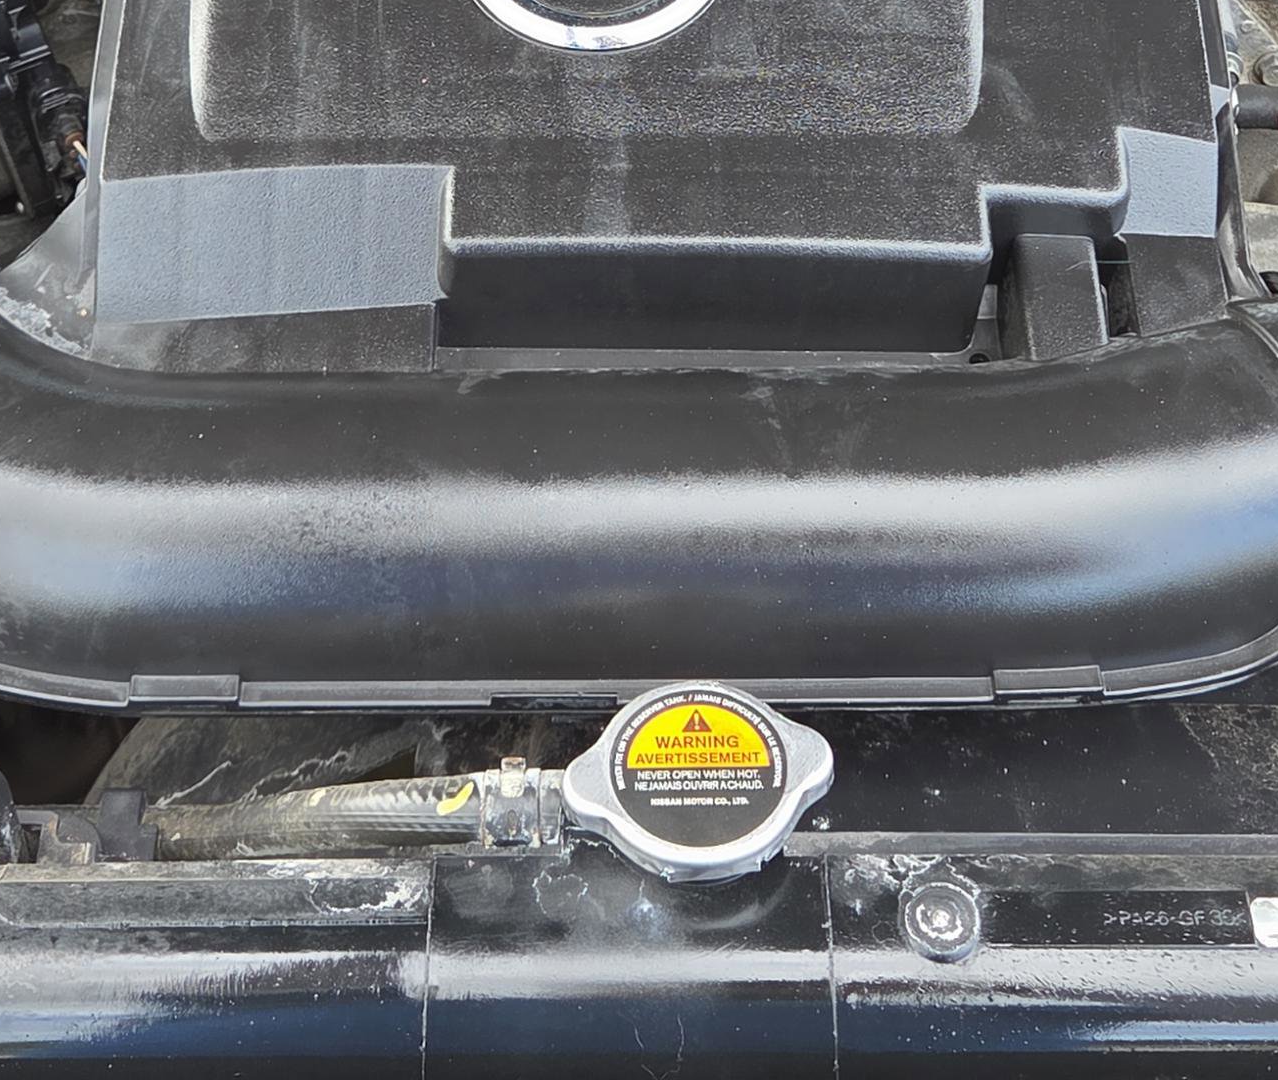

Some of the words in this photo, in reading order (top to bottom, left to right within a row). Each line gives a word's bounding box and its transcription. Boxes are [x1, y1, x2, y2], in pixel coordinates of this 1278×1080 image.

[655, 735, 739, 749] WARNING
[635, 751, 761, 764] AVERTISSEMENT
[637, 770, 671, 780] NEVER
[672, 770, 701, 780] OPEN
[703, 769, 736, 779] WHEN
[737, 769, 761, 779] HOT.
[634, 781, 648, 791] NE
[648, 781, 682, 791] JAMAIS
[683, 780, 720, 790] OUVRIR
[650, 797, 682, 806] NISSAN
[683, 797, 713, 806] MOTOR
